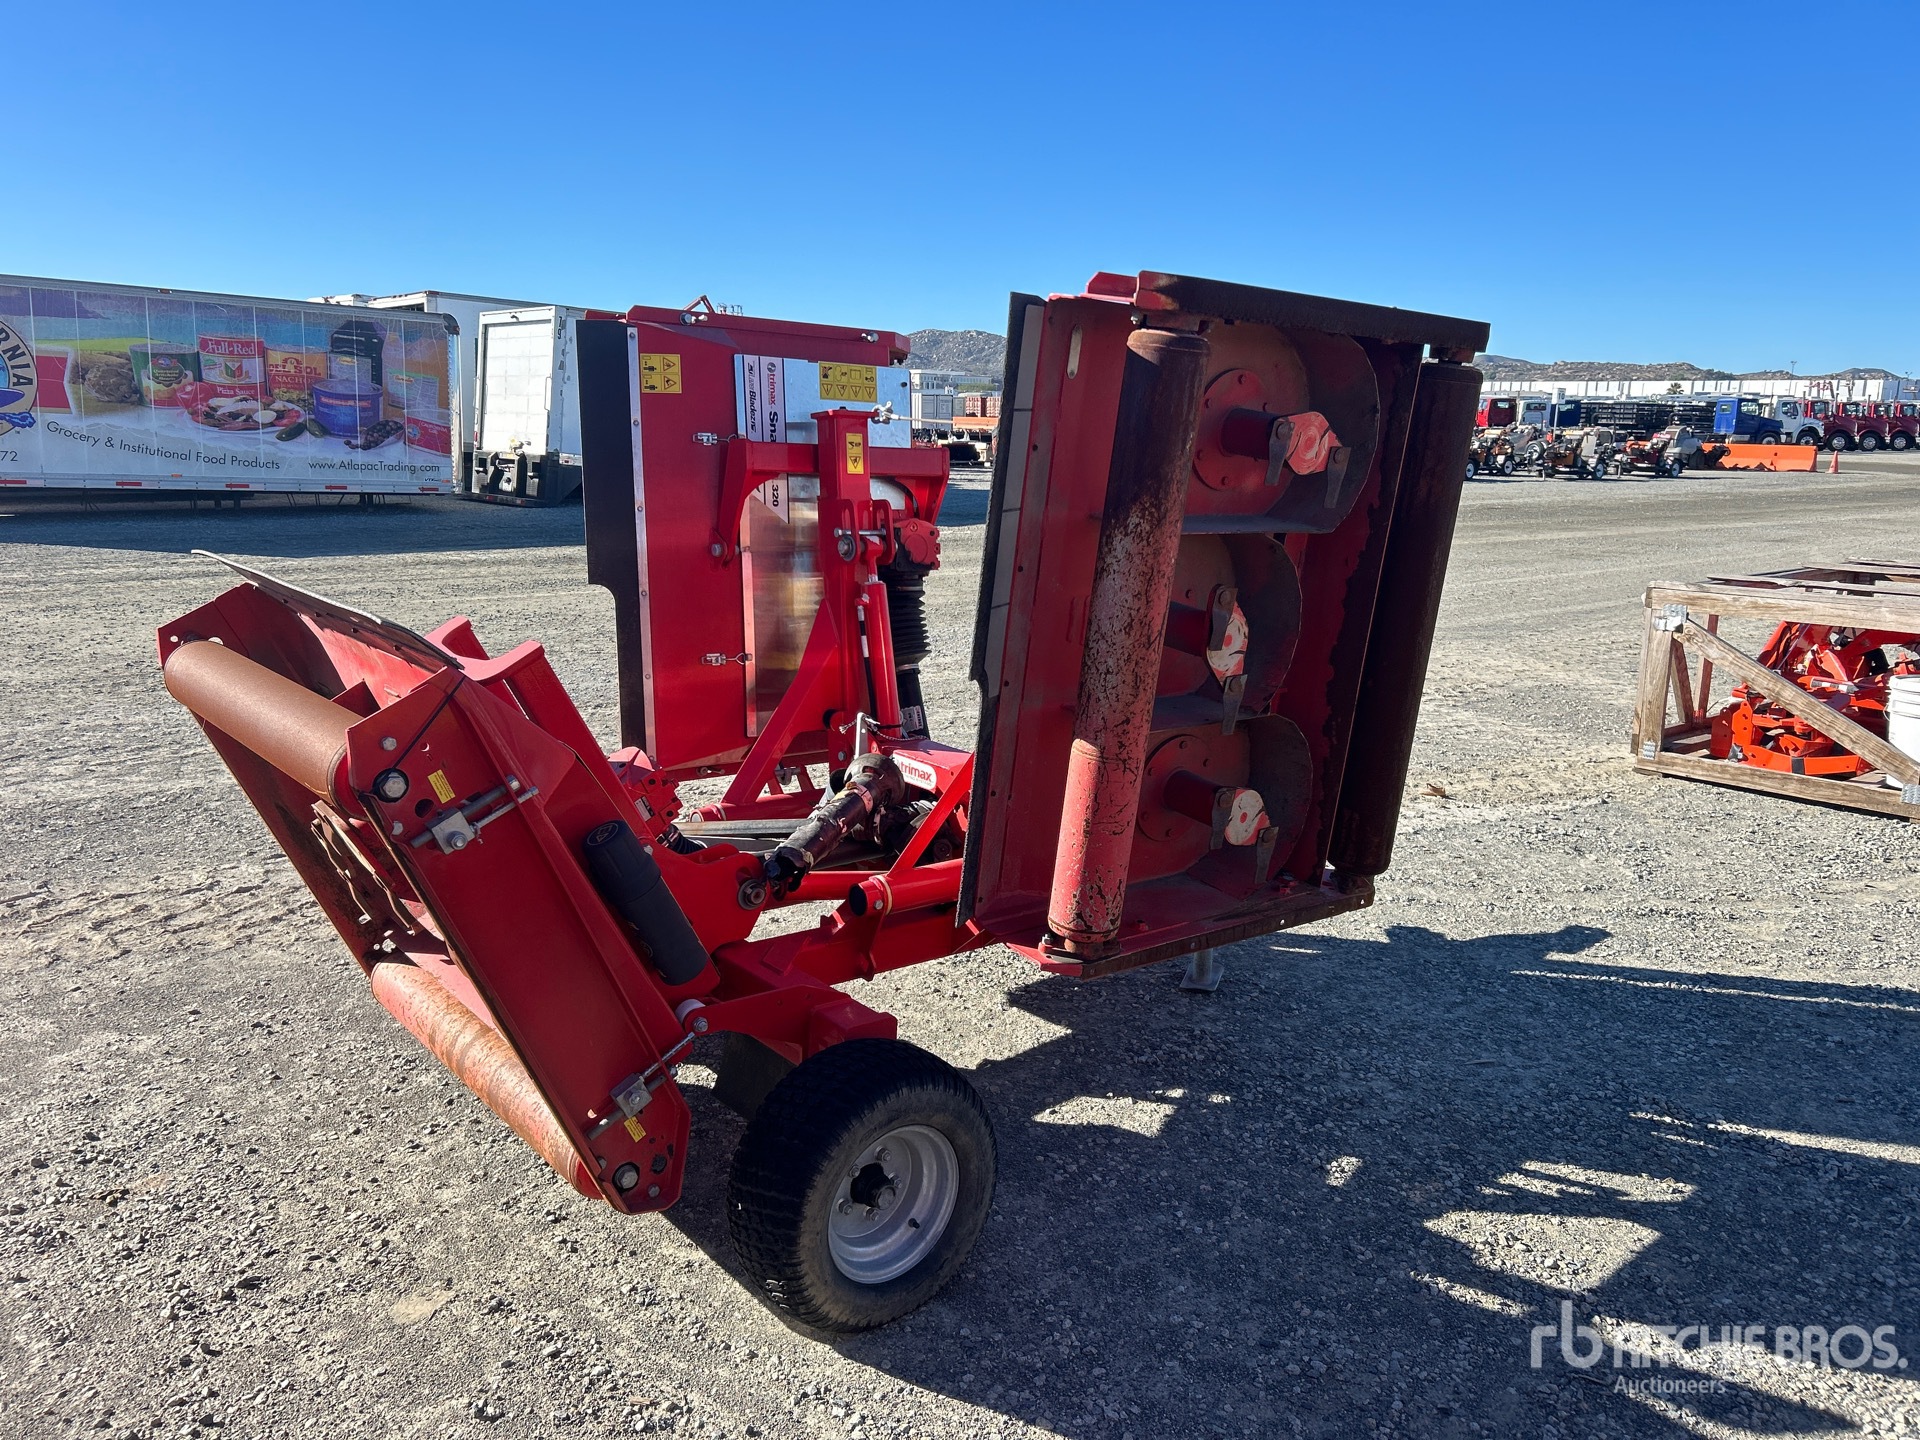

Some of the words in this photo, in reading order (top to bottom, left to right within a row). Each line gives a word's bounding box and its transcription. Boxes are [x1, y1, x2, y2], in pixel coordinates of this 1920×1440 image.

[208, 340, 256, 355] Full-Red
[294, 365, 322, 376] SOL
[235, 387, 255, 396] Sauce
[769, 411, 778, 442] Sna
[46, 420, 101, 447] Grocery
[104, 436, 115, 449] &
[119, 439, 192, 462] Institutional
[196, 451, 226, 466] Food
[231, 456, 281, 470] Products
[308, 459, 440, 475] www.AtlapacTrading.com
[901, 761, 932, 782] trimax
